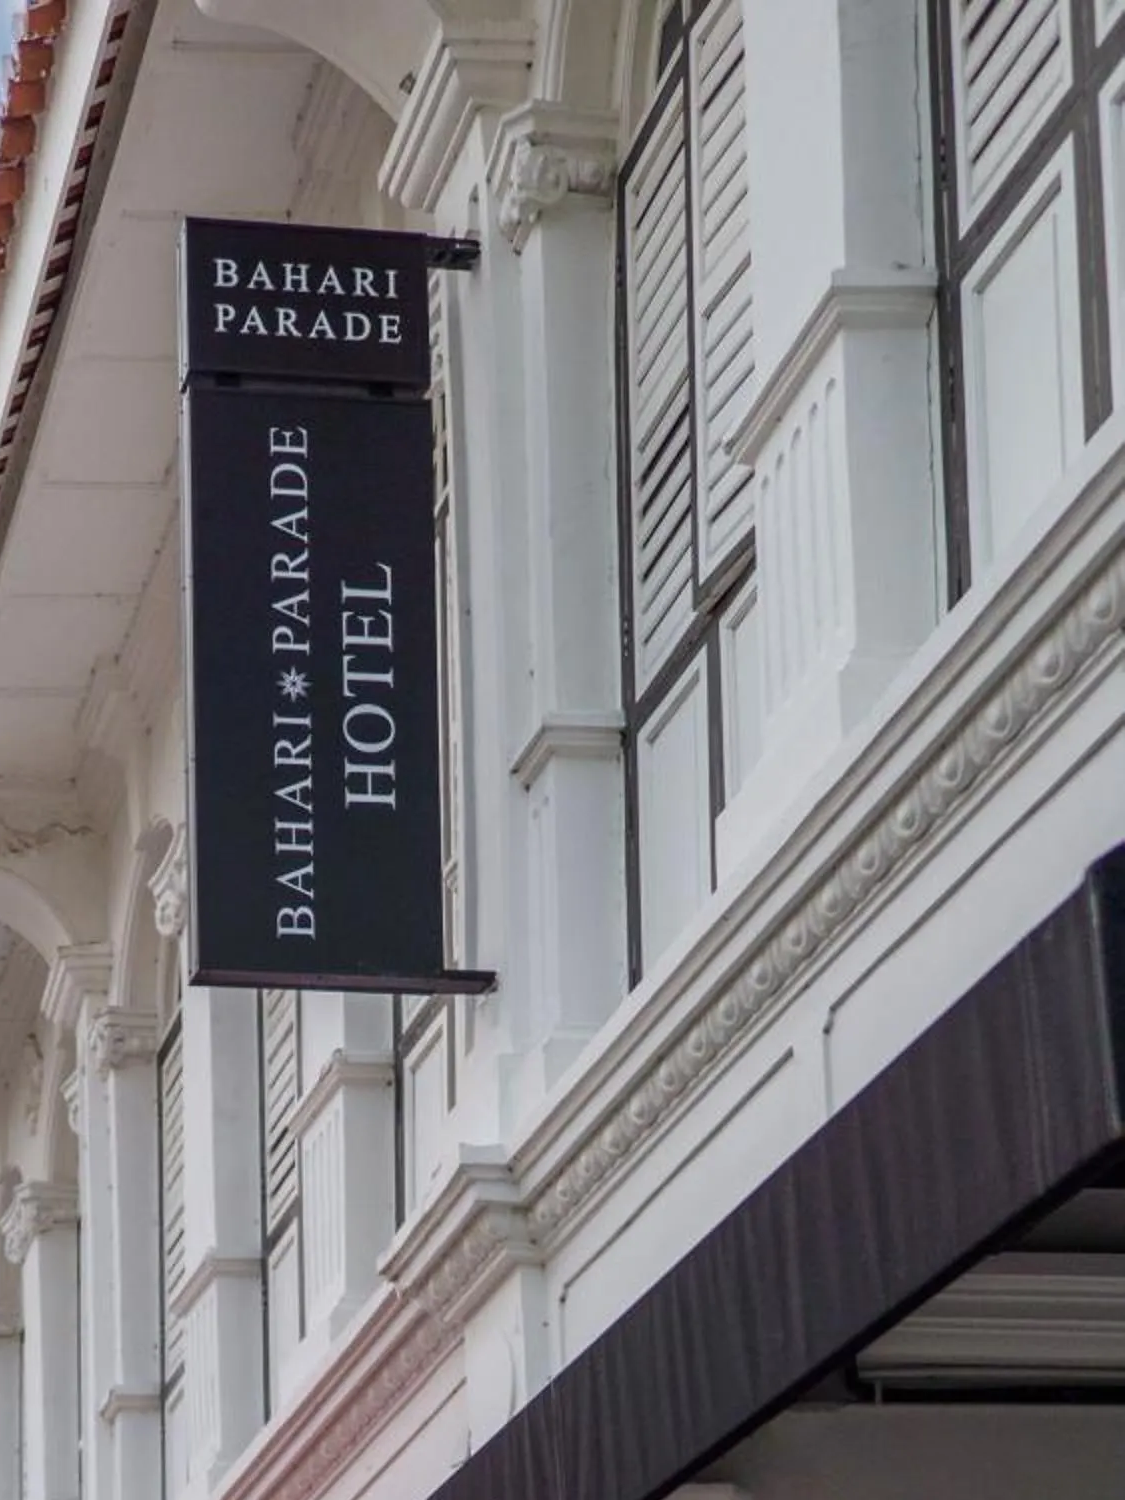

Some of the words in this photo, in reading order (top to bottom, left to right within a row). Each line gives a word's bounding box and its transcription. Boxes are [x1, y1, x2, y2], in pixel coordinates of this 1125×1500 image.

[213, 257, 398, 299] BAHARI
[214, 303, 402, 345] PARADE
[270, 426, 310, 656] PARADE
[341, 562, 396, 810] HOTEL
[272, 712, 316, 940] BAHARI
